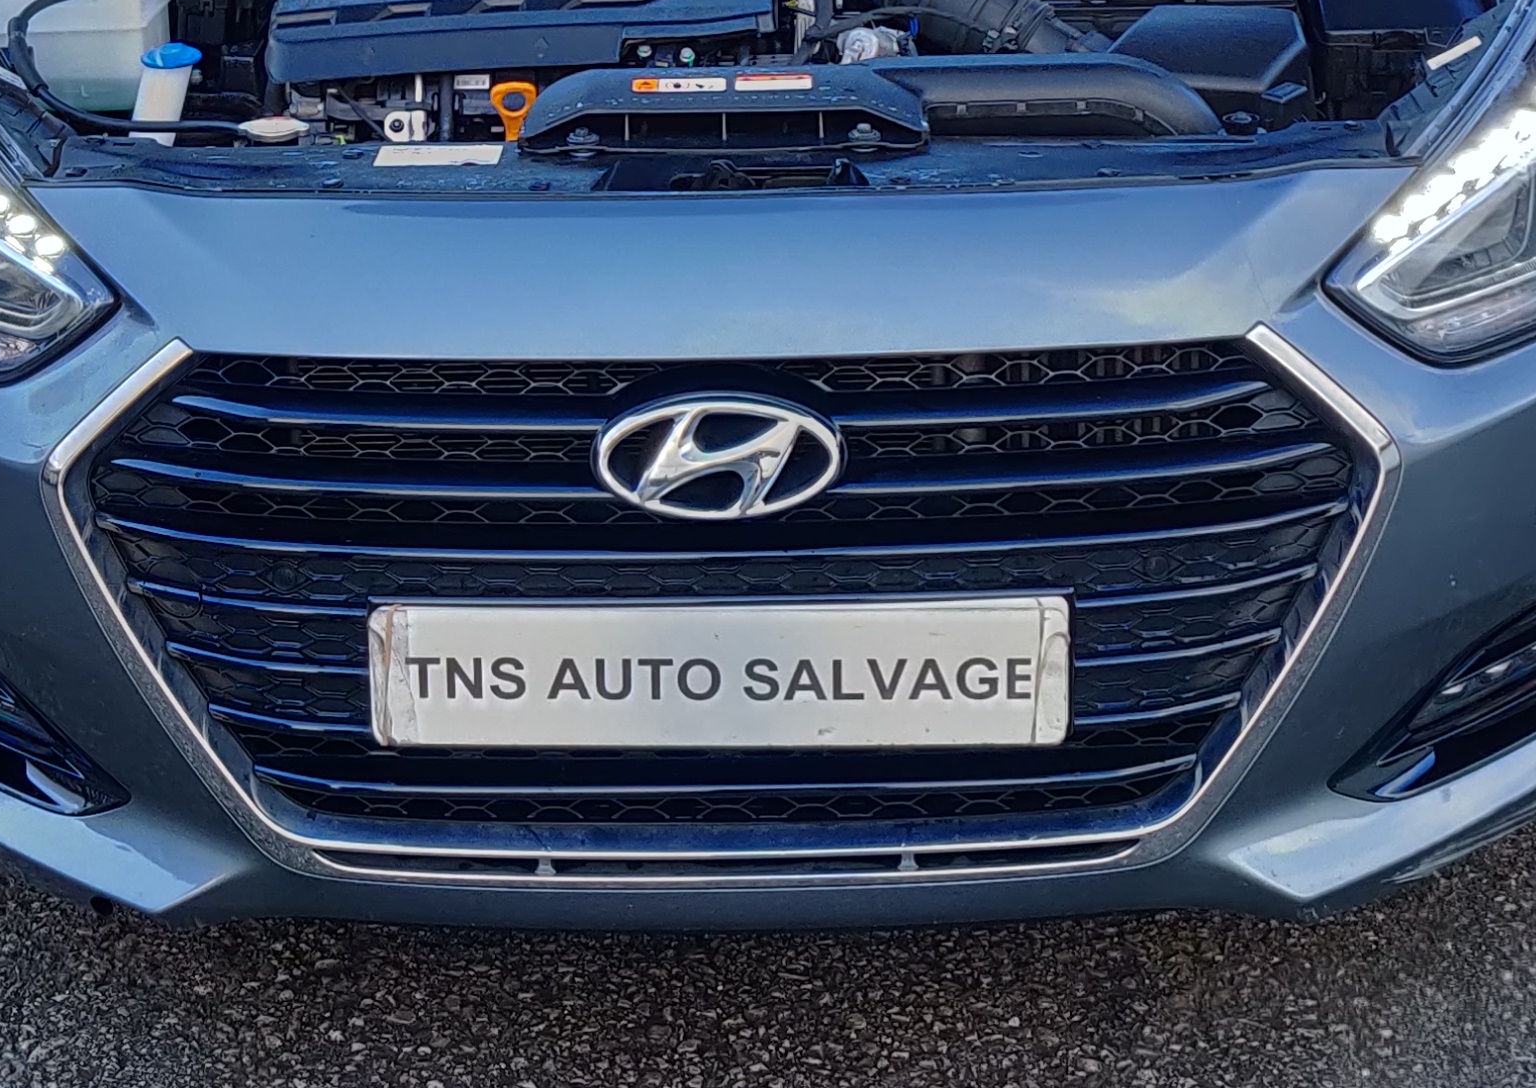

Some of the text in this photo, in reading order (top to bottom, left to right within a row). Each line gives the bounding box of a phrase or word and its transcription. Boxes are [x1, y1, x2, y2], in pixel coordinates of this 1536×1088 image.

[404, 656, 1032, 702] TNS AUTO SALVAGE
